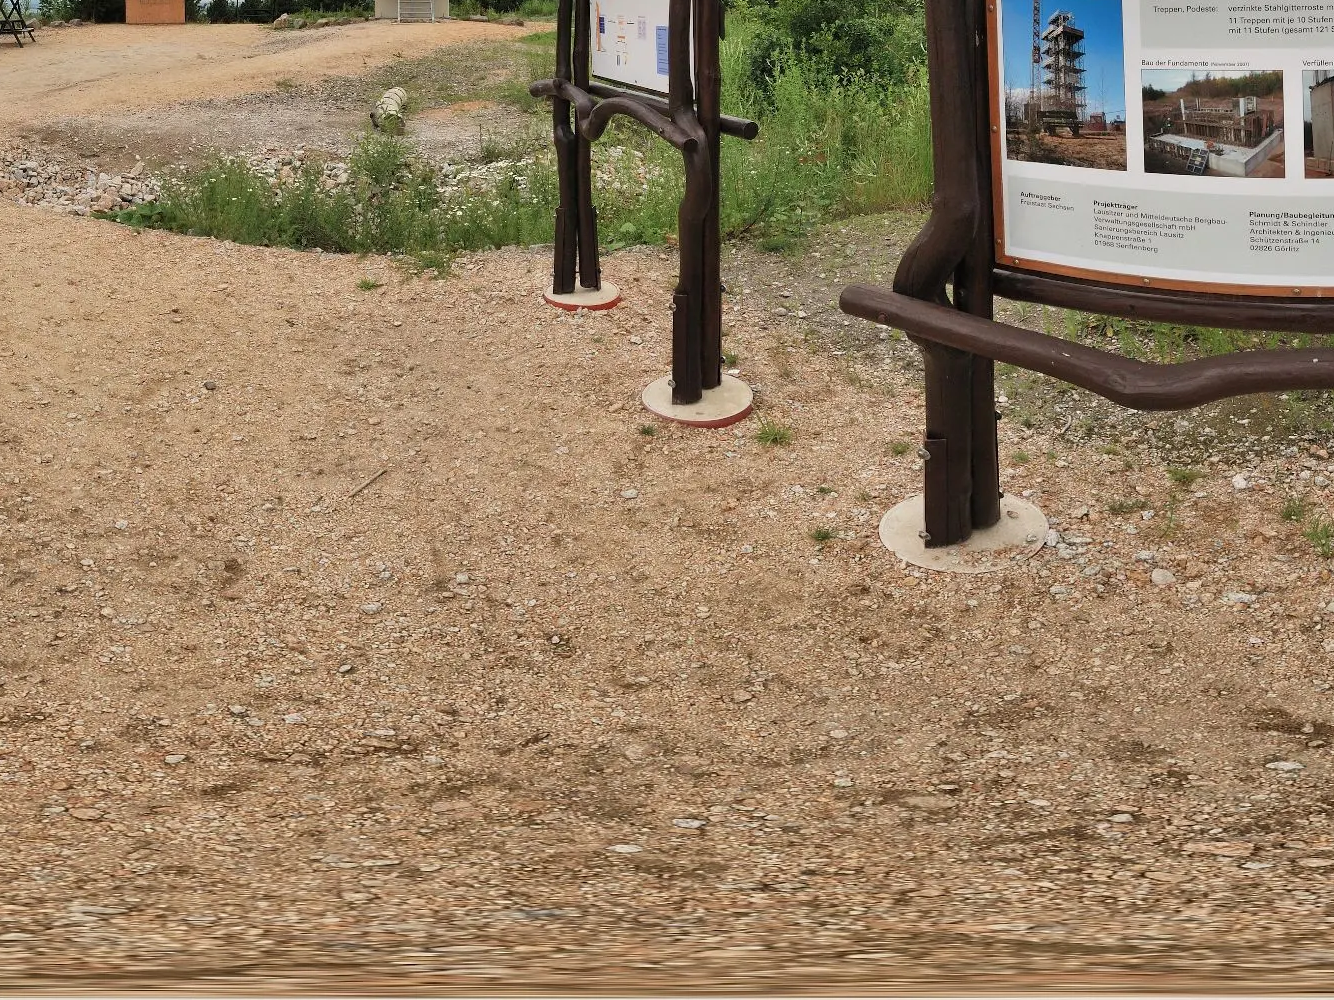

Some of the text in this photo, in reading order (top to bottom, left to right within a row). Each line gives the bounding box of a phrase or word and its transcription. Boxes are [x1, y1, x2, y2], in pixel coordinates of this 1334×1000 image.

[1187, 5, 1218, 13] Podeste:
[1228, 4, 1262, 12] verzinkte
[1264, 4, 1324, 13] Stahlgitterroste
[1240, 17, 1270, 25] Treppen
[1287, 17, 1294, 25] je
[1281, 26, 1313, 35] (gesamt
[1302, 59, 1334, 67] Verfüllen
[1020, 191, 1061, 202] Auftraggeber
[1020, 199, 1046, 208] Freistaat
[1093, 200, 1138, 211] Projektträger
[1093, 208, 1124, 217] Lausitzer
[1125, 211, 1139, 219] und
[1140, 212, 1193, 223] Mitteldeutsche
[1094, 216, 1196, 231] Verwaltungsgesellschaft mbH
[1094, 224, 1185, 239] Sanierungsbereich Lausitz
[1249, 228, 1293, 236] Architekten
[1094, 232, 1146, 244] Knappenstraße
[1116, 242, 1158, 253] Senftenberg
